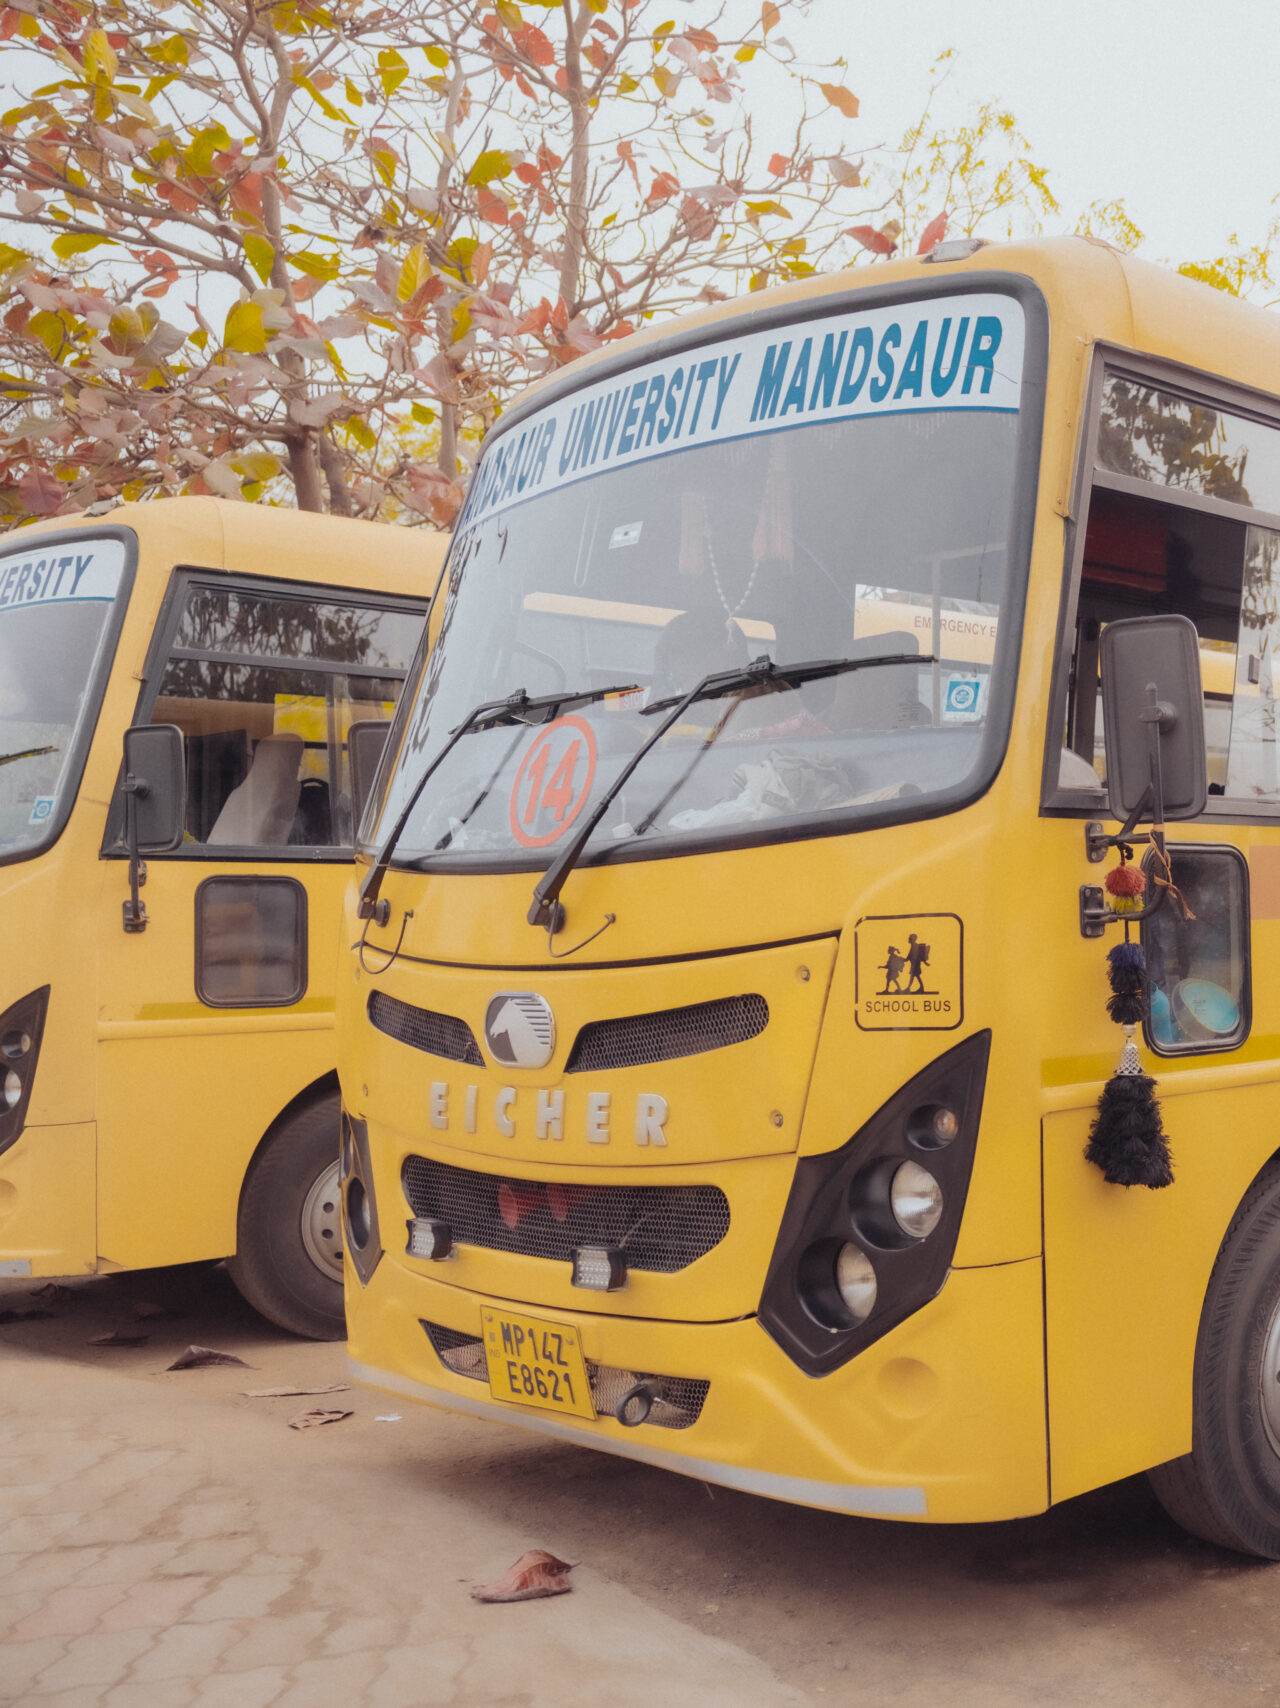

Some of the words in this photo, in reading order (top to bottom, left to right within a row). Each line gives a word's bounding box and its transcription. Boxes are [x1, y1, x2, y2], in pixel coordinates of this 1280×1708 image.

[559, 353, 742, 477] UNIVERSITY
[749, 316, 1002, 422] MANDSAUR
[914, 615, 987, 636] EMRGENCY
[523, 739, 581, 825] 14
[865, 1000, 919, 1013] SCHOOL
[923, 1000, 952, 1012] BUS
[429, 1081, 669, 1147] EICHER
[500, 1321, 568, 1367] MP14Z
[506, 1360, 576, 1405] E8621
